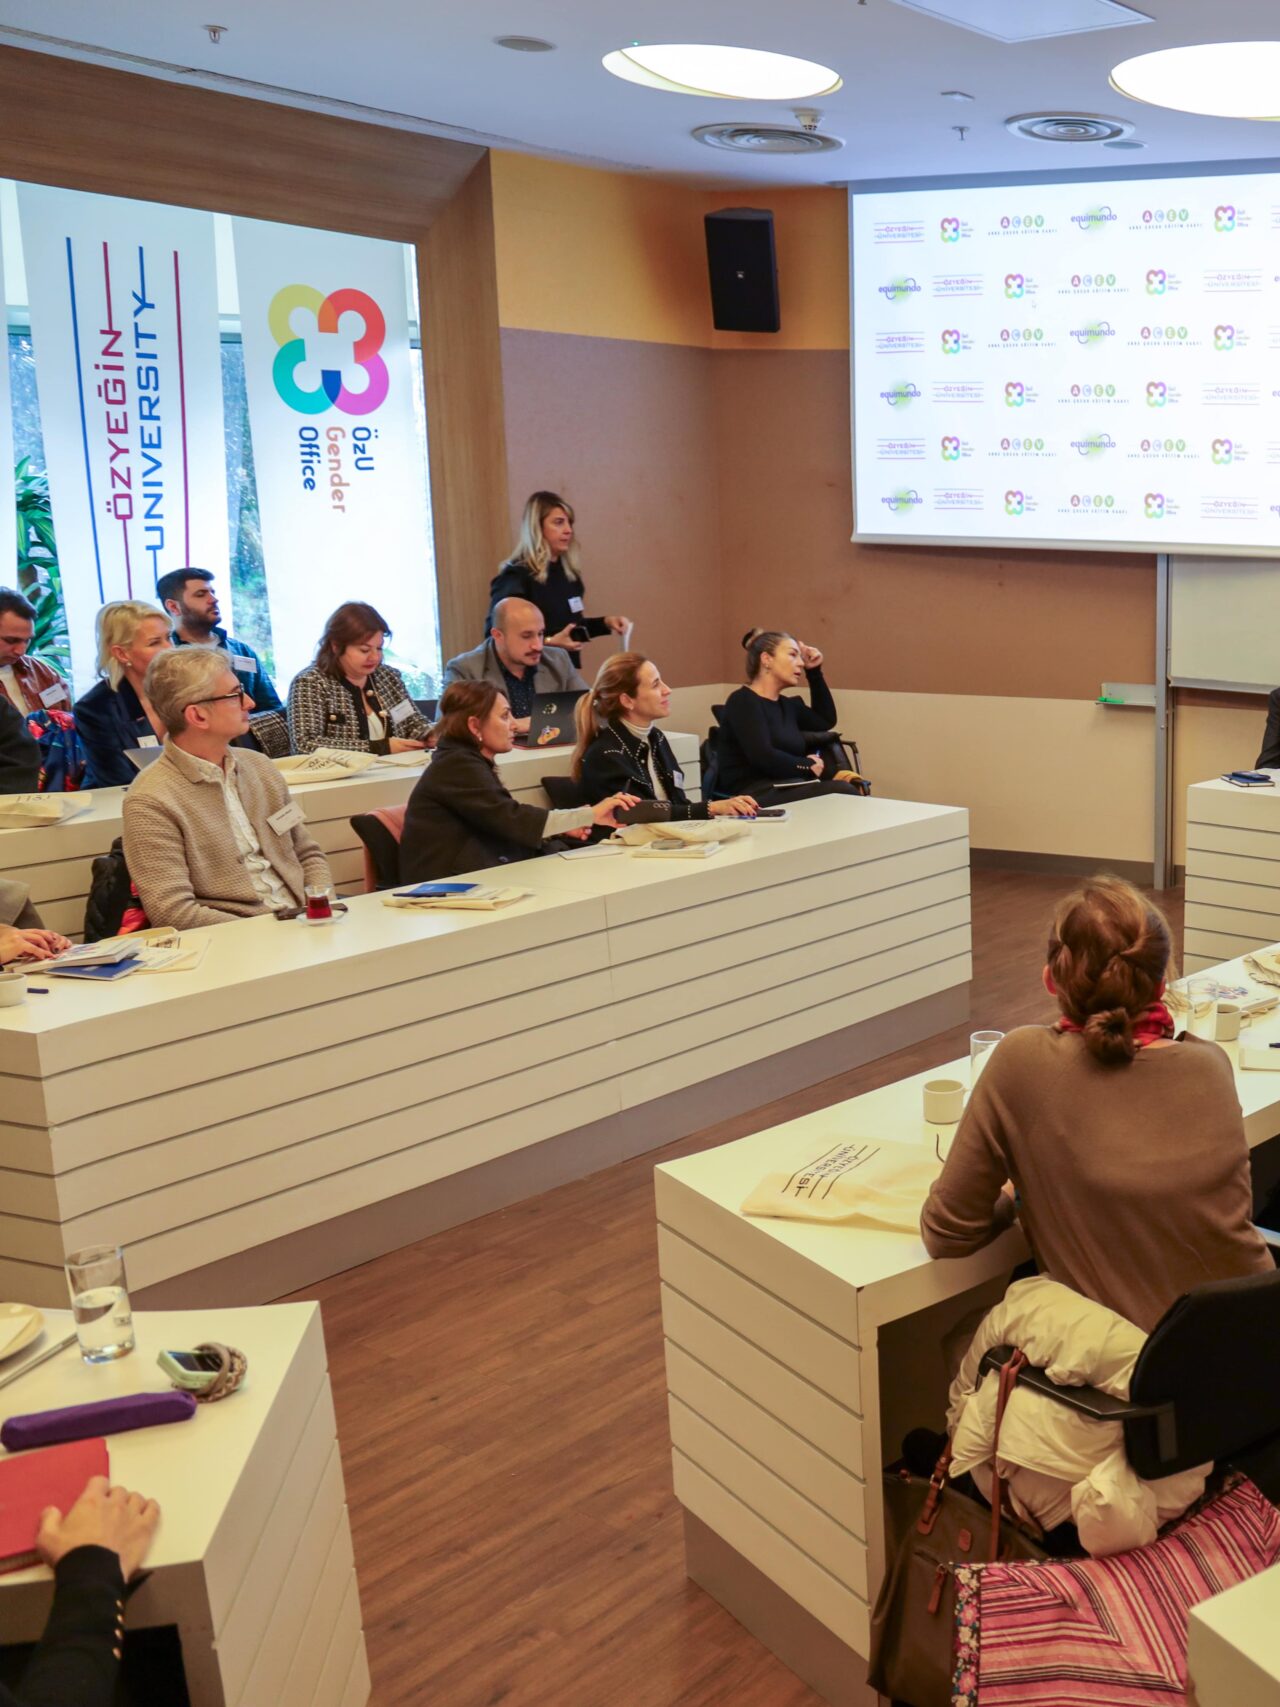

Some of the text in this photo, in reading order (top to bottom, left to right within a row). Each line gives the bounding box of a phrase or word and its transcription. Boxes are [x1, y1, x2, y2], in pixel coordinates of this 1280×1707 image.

[1071, 206, 1117, 229] equimundo
[1070, 322, 1115, 344] equimundo
[94, 328, 134, 521] ÖZYEĞİN
[132, 290, 165, 551] UNIVERSITY
[1071, 434, 1116, 455] equimundo
[299, 426, 321, 492] Office
[326, 426, 351, 513] Gender
[352, 426, 379, 471] ÖzU
